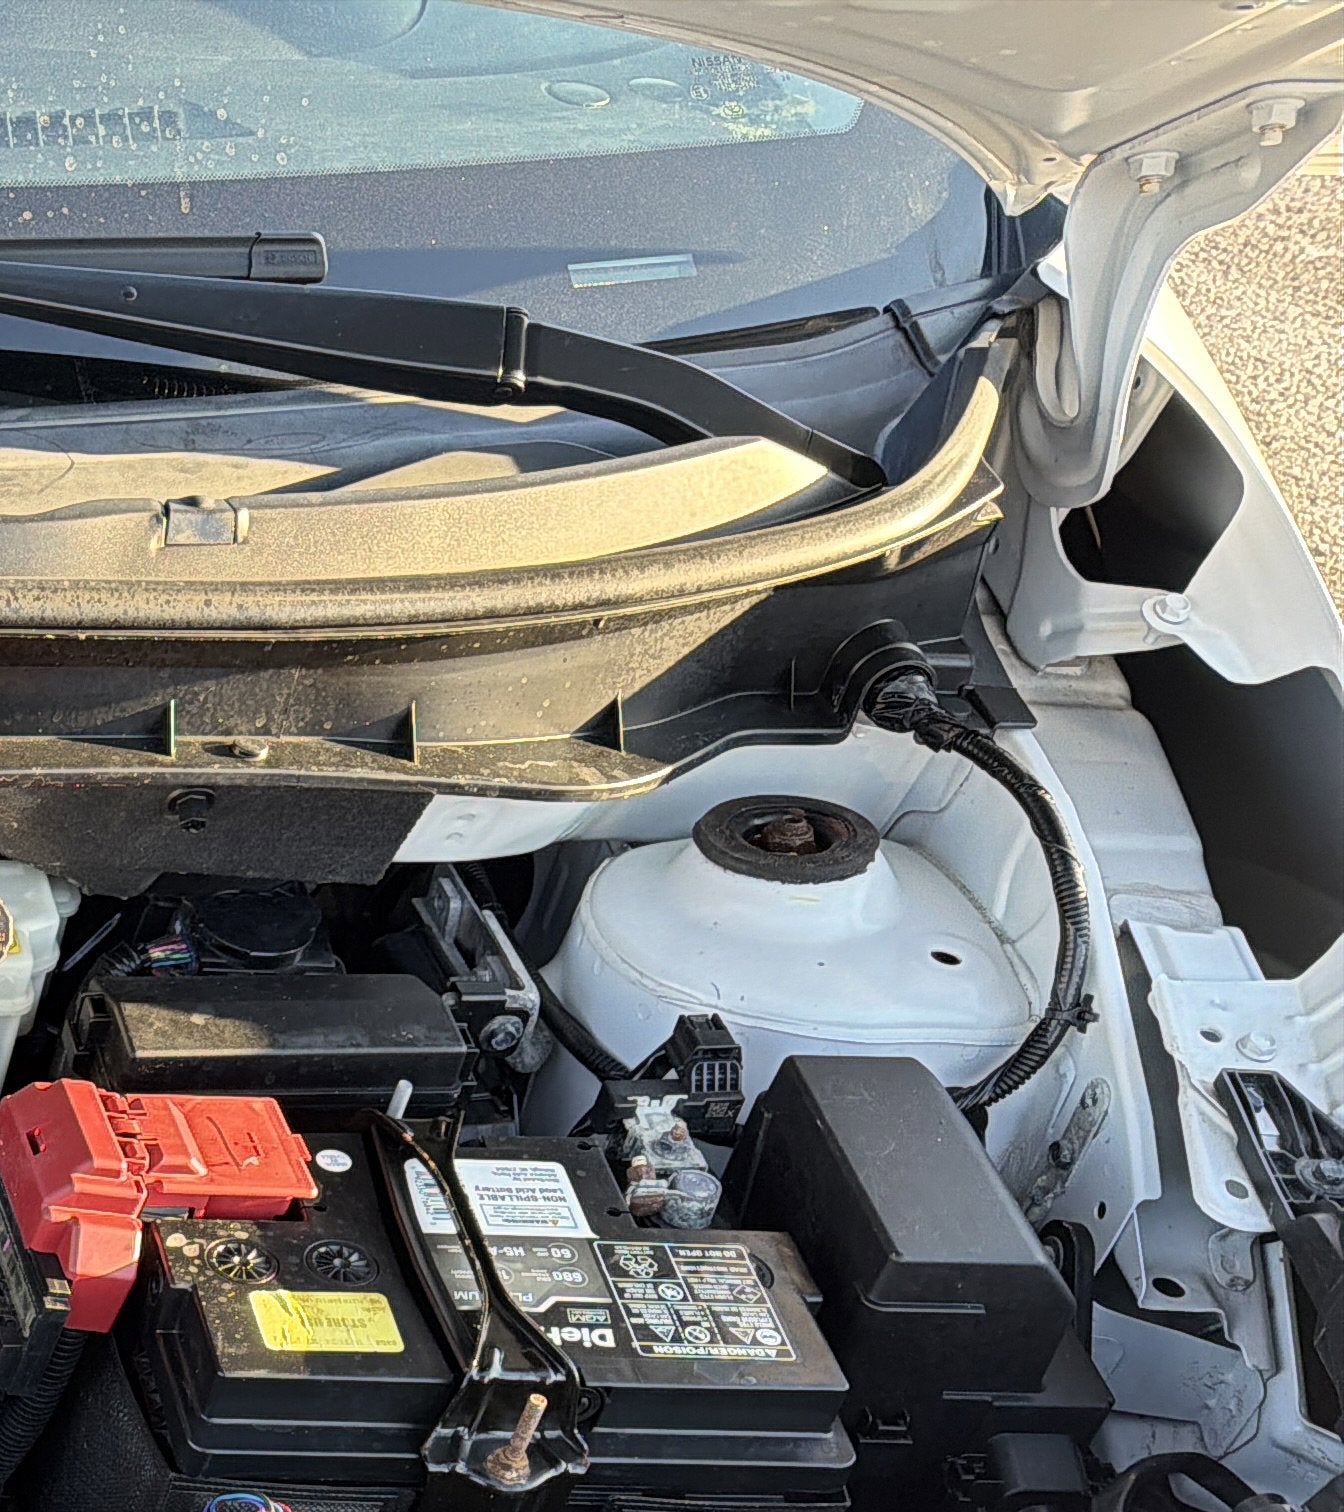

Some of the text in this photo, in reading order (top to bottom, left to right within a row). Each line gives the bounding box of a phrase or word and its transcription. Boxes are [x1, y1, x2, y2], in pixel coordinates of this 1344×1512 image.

[691, 55, 742, 67] NISSAN
[514, 1186, 537, 1195] Acid
[476, 1192, 567, 1203] NON-SPILLABLE
[551, 1247, 572, 1259] 60
[551, 1270, 583, 1282] 680
[652, 1344, 767, 1357] DANGER/POISON
